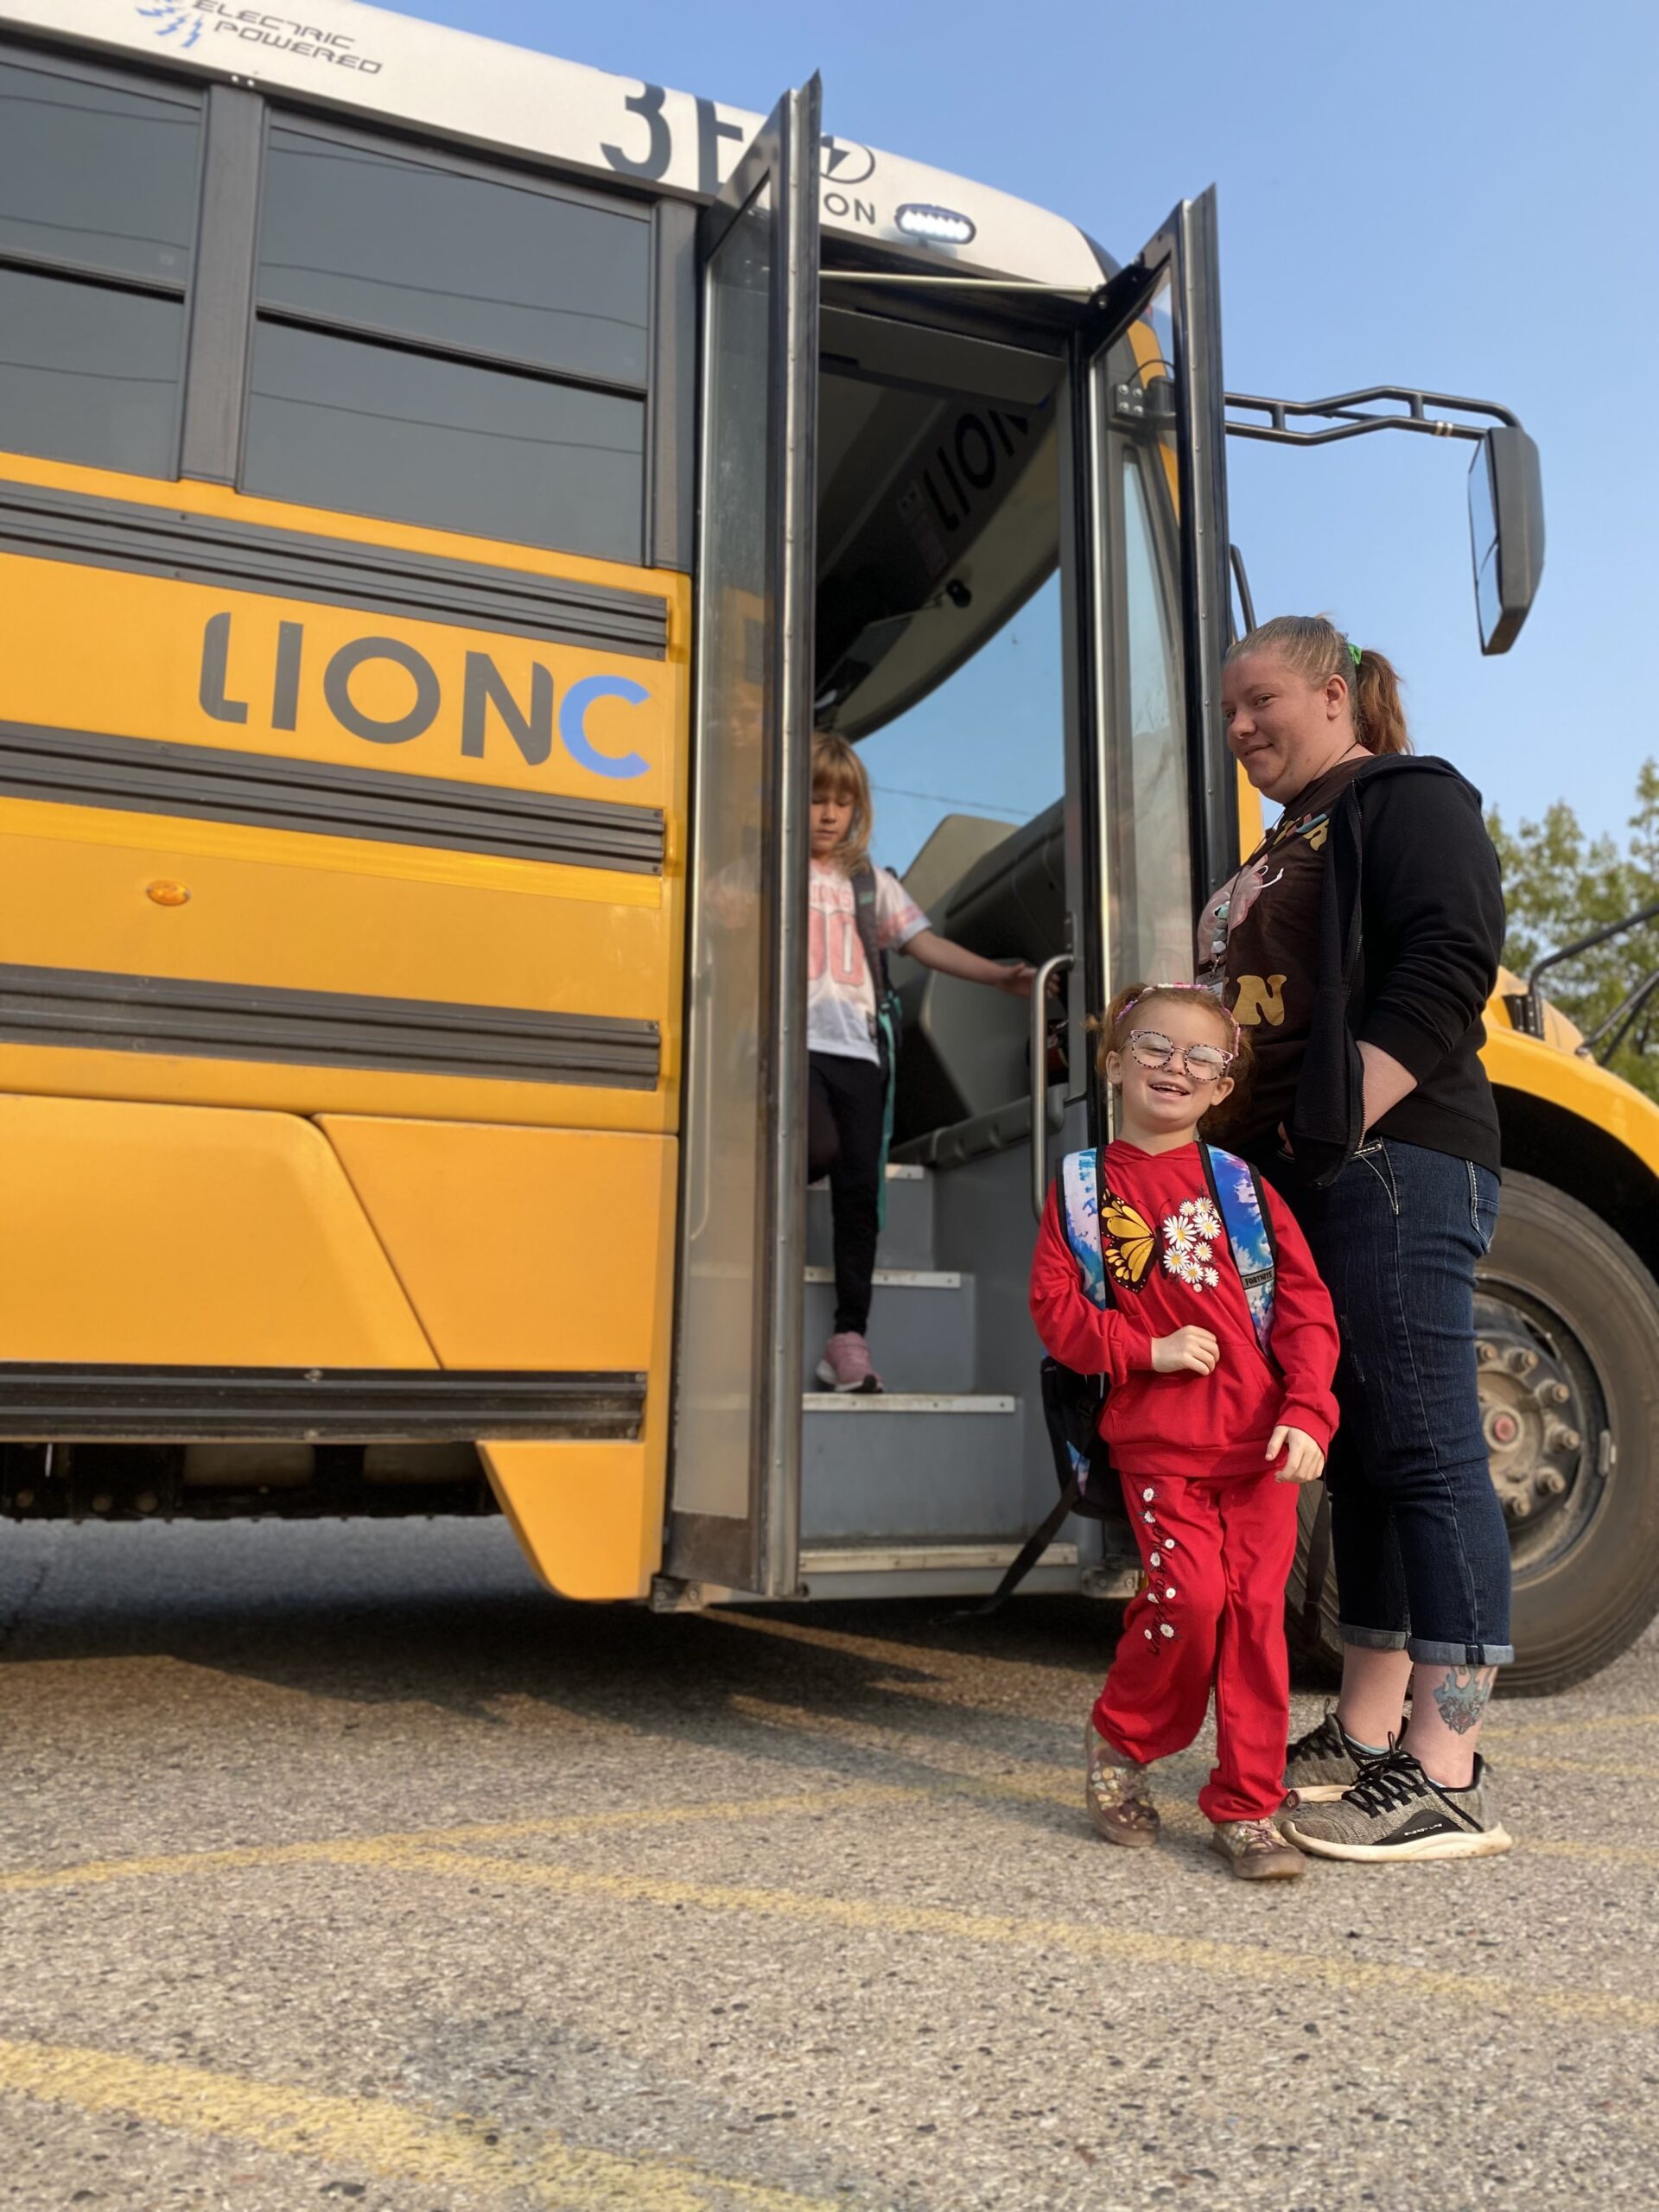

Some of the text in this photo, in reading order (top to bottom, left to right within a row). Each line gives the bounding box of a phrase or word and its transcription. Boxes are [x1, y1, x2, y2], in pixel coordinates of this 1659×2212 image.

[191, 0, 356, 50] ELECTRIC
[213, 20, 383, 74] POWERED
[823, 192, 876, 225] ON
[809, 883, 853, 908] IONS
[1244, 1270, 1273, 1286] FORTNITE
